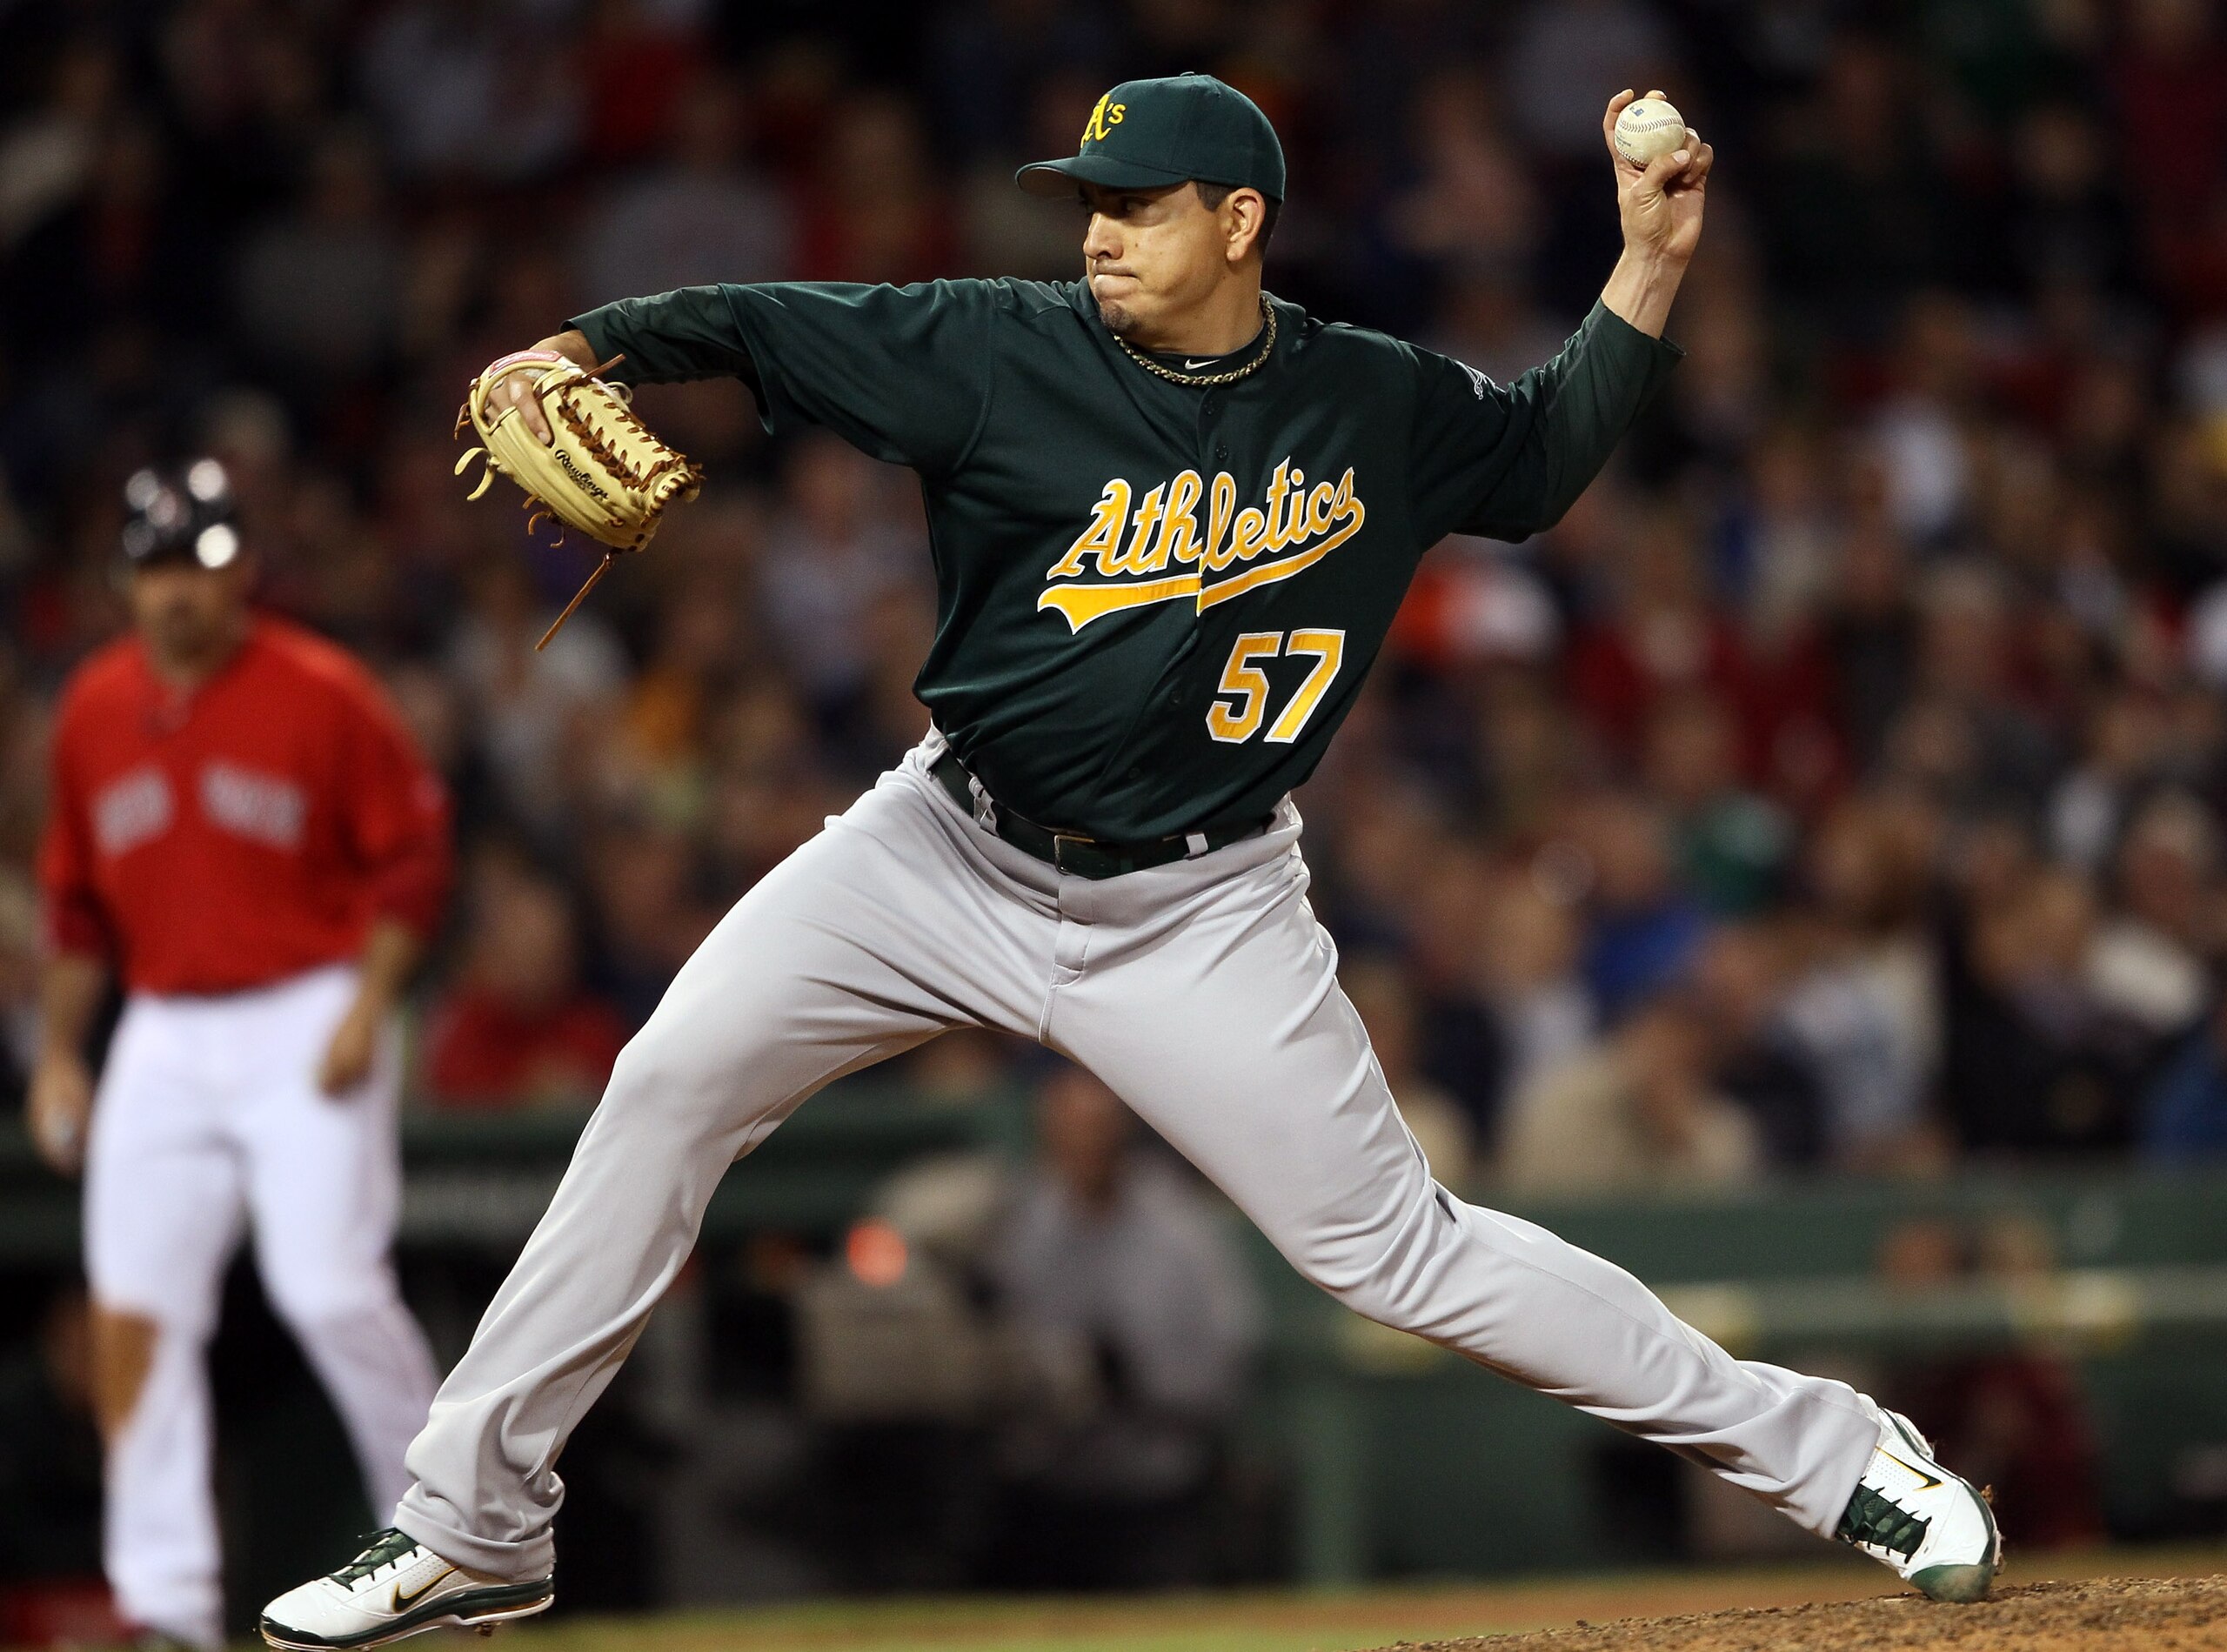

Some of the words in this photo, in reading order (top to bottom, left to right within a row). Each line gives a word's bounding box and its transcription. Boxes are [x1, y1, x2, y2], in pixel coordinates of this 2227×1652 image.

[1080, 93, 1126, 148] A's
[555, 449, 609, 499] Rawlings
[1046, 456, 1365, 582] Athletics
[1206, 628, 1346, 744] 57
